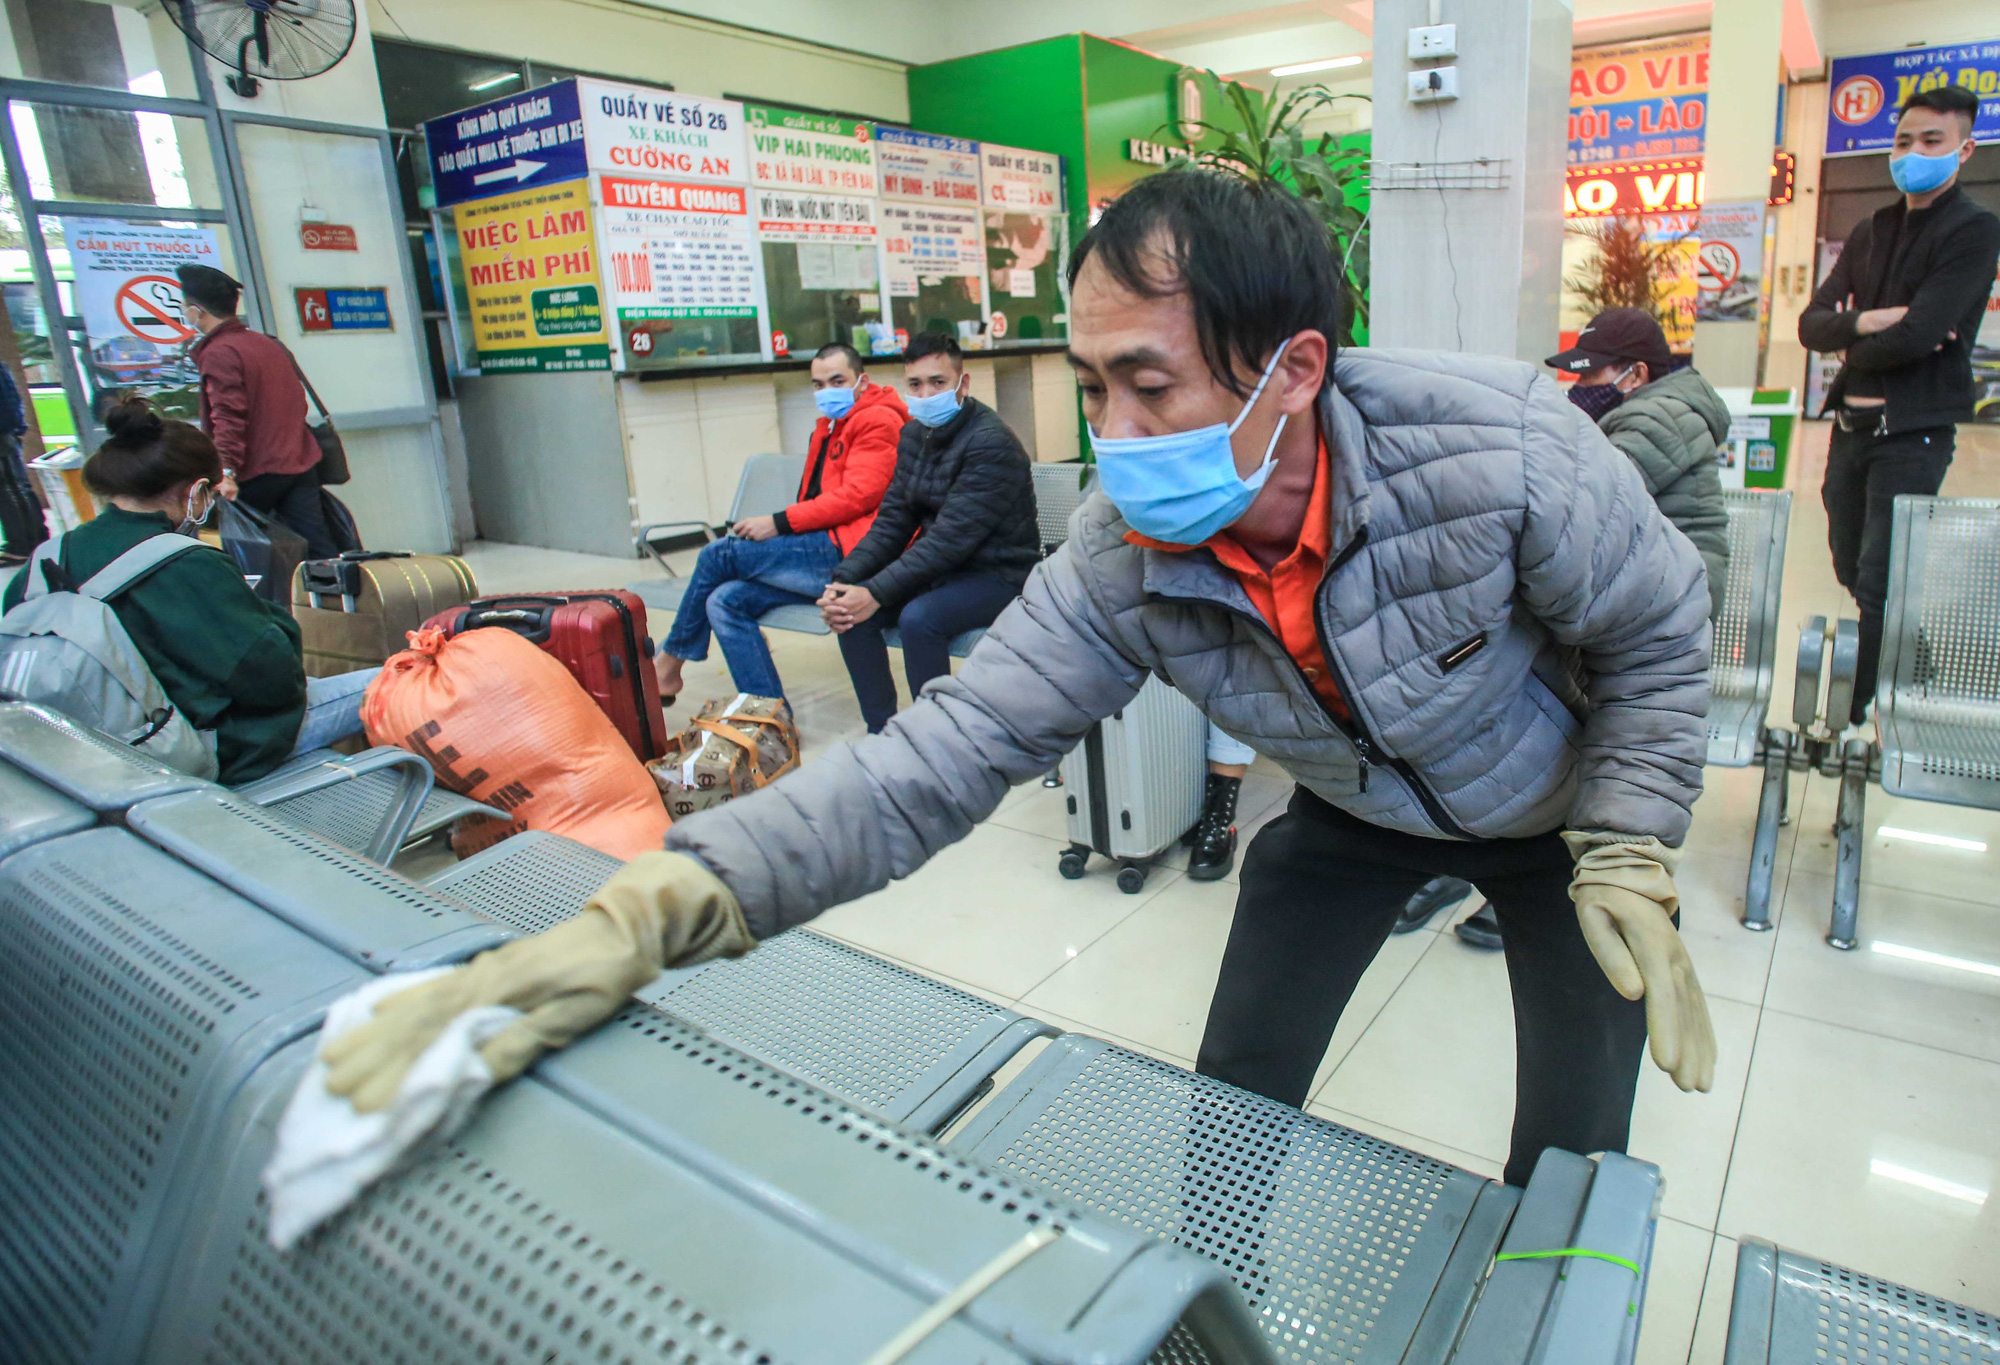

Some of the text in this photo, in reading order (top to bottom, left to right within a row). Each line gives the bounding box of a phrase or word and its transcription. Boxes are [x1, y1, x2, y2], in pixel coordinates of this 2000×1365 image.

[457, 97, 552, 141] KÍNH MỜI QUÝ KHÁCH
[654, 101, 675, 124] VÉ
[681, 103, 702, 127] SỐ
[707, 112, 728, 131] 26
[1639, 97, 1705, 134] LÀO
[439, 151, 455, 173] VÀO
[477, 141, 499, 164] MUA
[498, 135, 510, 159] VÉ
[510, 127, 540, 156] TRƯỚC
[540, 127, 558, 149] KHI
[557, 123, 570, 144] ĐI
[569, 119, 584, 142] XE
[628, 125, 708, 147] XE KHÁCH
[754, 134, 779, 153] VIP
[609, 144, 730, 176] CƯỜNG AN
[1130, 138, 1165, 167] KEM
[612, 181, 741, 211] TUYÊN QUANG
[463, 210, 586, 251] VIỆC LÀM
[626, 213, 735, 227] XE CHẠY CAO TỐC
[76, 236, 212, 254] CẤM HÚT THUỐC LÁ
[470, 244, 591, 286] MIỄN PHÍ
[632, 333, 651, 351] 26
[1570, 358, 1591, 370] NIKE
